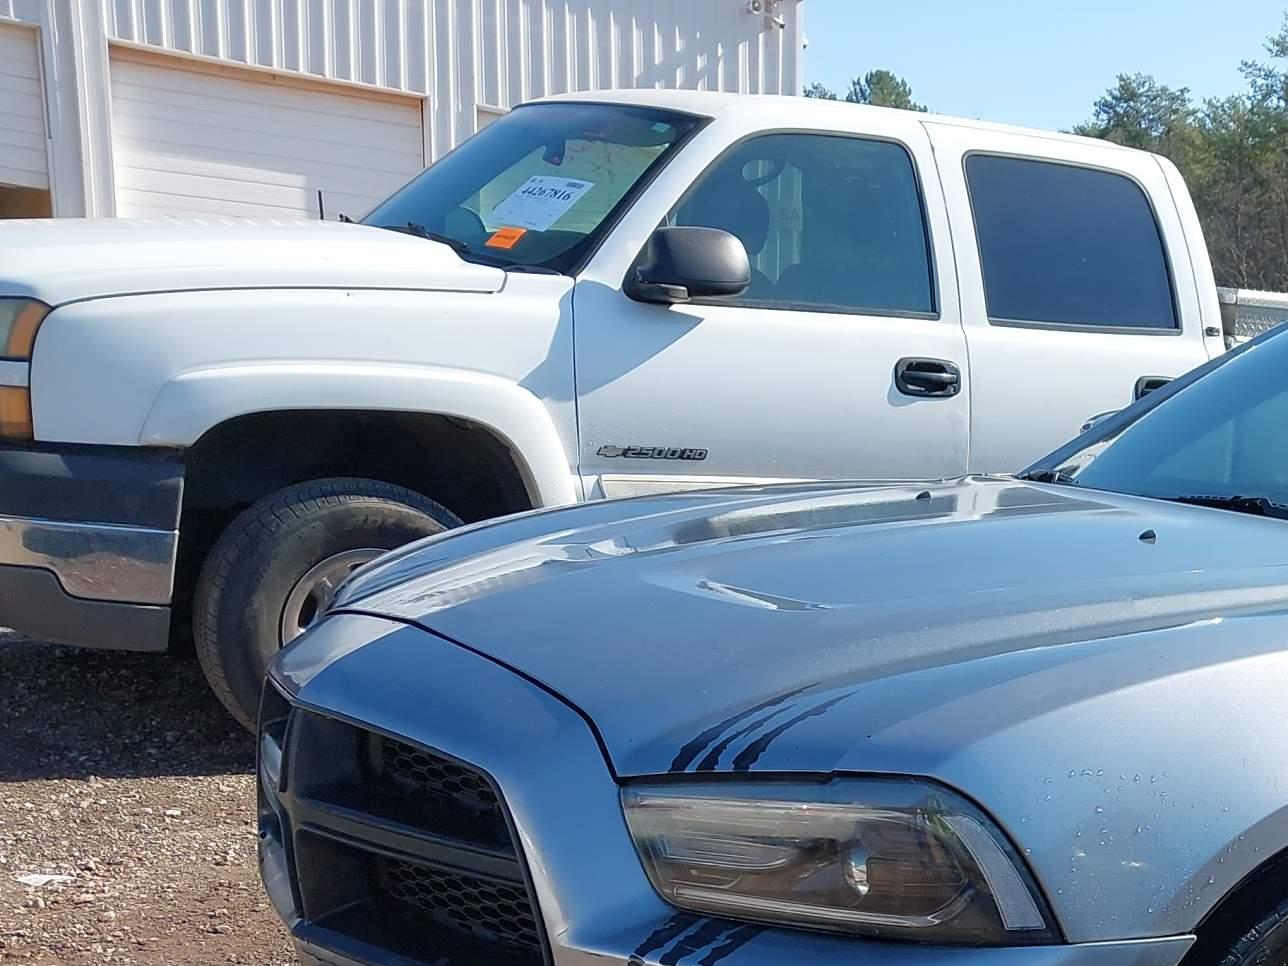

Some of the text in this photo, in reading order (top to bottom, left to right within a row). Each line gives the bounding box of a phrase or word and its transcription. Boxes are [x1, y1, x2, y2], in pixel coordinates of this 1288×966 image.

[521, 185, 575, 202] 44267816
[625, 446, 707, 460] 2500 HD
